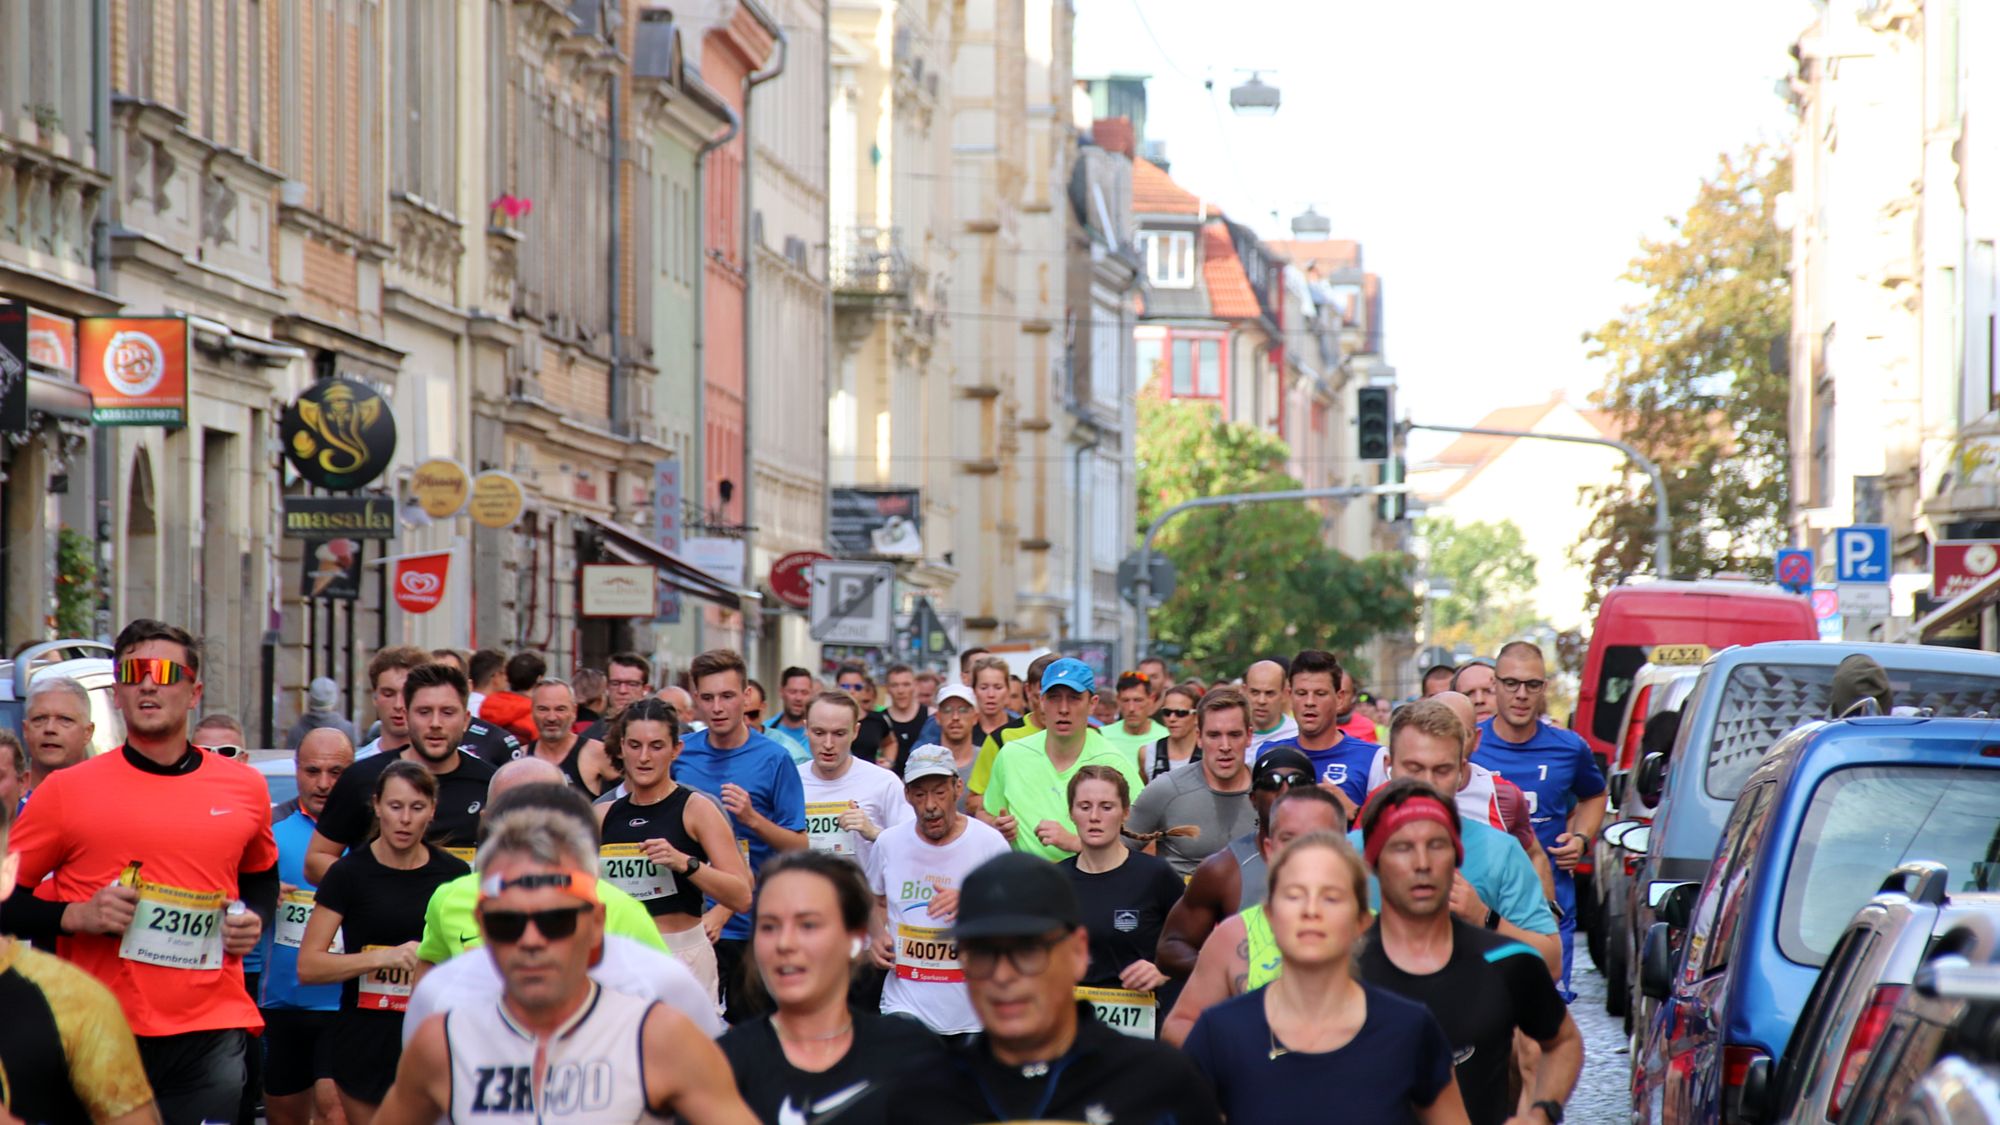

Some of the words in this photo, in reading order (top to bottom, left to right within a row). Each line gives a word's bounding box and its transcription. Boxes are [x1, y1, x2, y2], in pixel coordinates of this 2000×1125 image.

[288, 500, 391, 529] masala
[1842, 531, 1875, 578] P
[606, 859, 657, 878] 21670
[148, 907, 214, 937] 23169
[287, 904, 314, 924] 23
[137, 948, 198, 965] Piepenbrock
[906, 940, 959, 961] 40078
[375, 967, 409, 985] 401
[919, 973, 950, 982] Sparkasse
[1095, 1005, 1142, 1027] 2417
